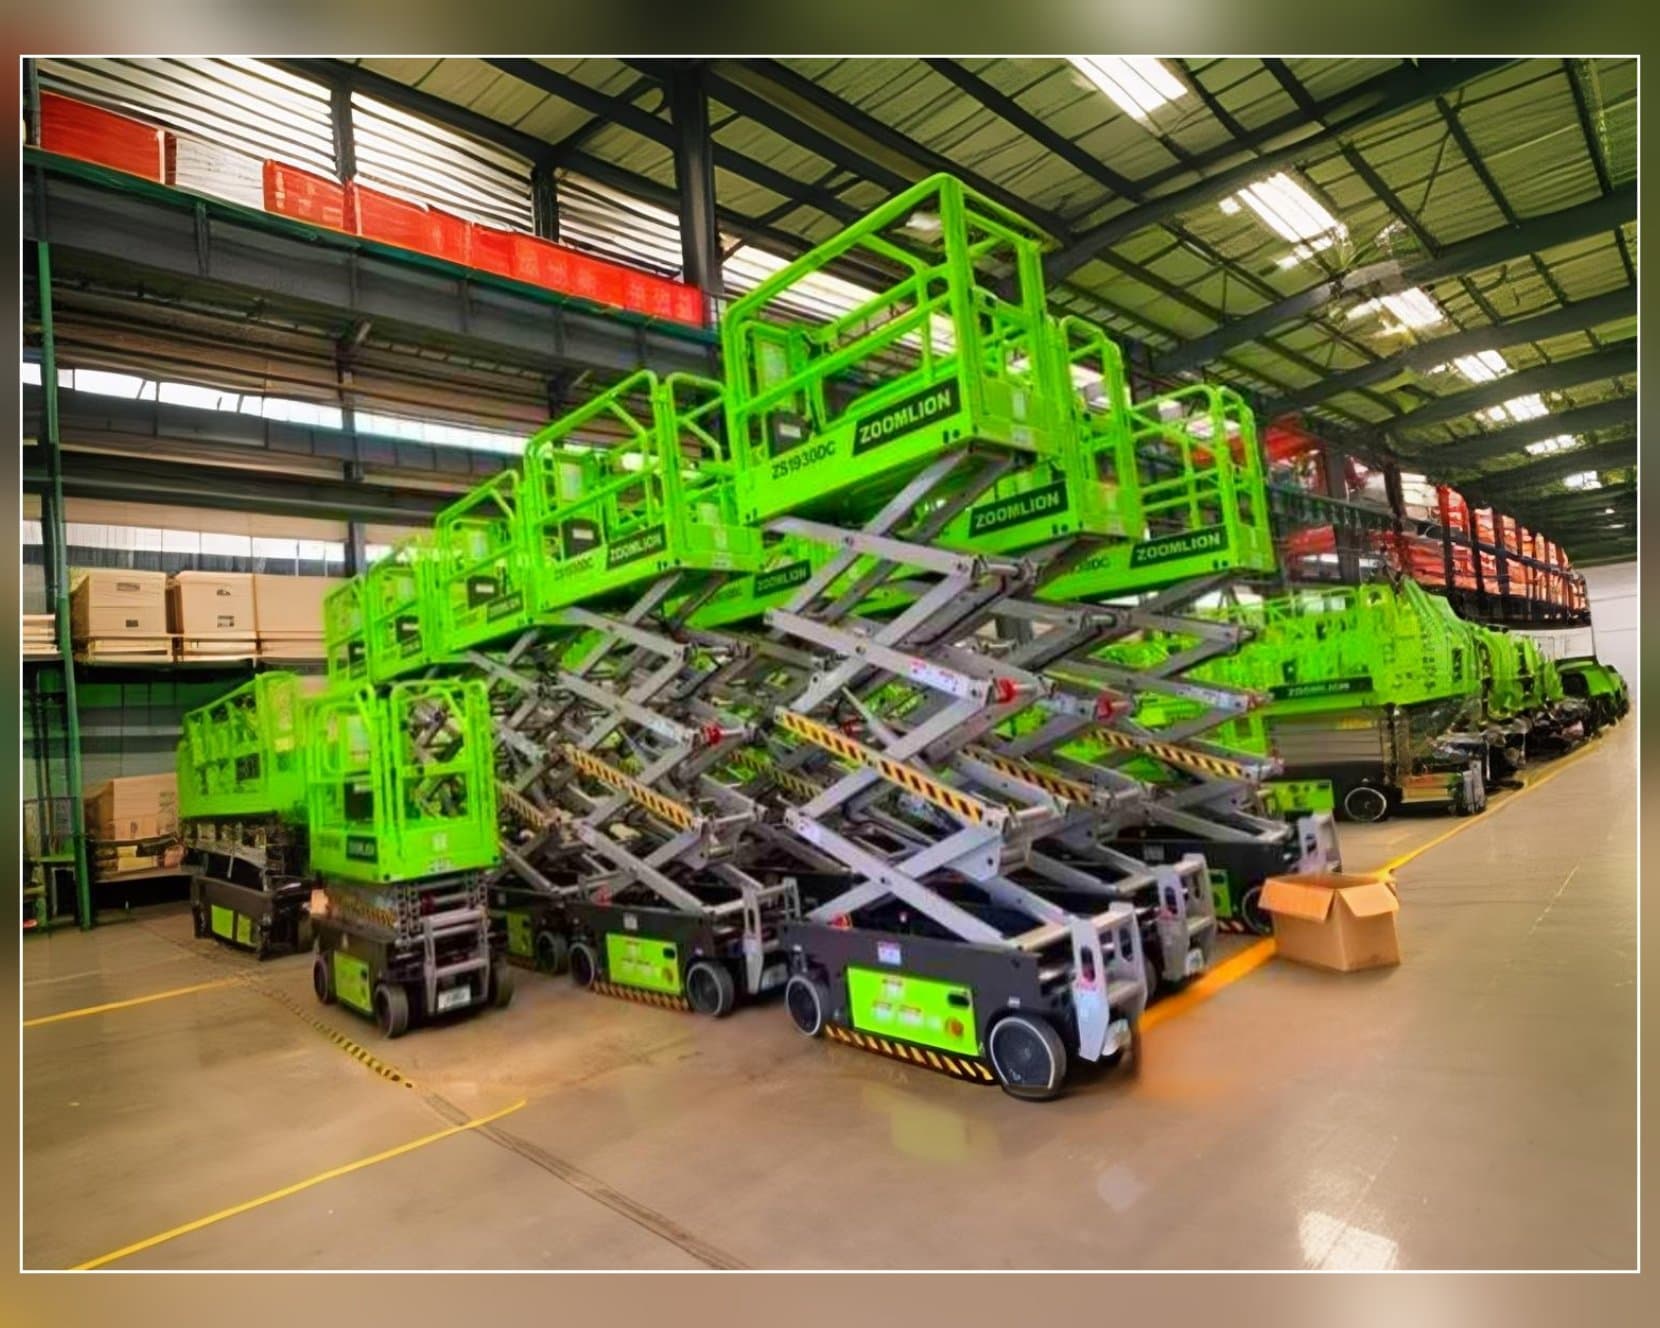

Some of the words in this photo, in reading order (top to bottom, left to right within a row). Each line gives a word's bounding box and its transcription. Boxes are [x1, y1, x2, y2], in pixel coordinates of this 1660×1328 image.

[859, 389, 951, 444] ZOOMLION
[975, 491, 1060, 529] ZOOMLION
[1137, 532, 1221, 561] ZOOMLION
